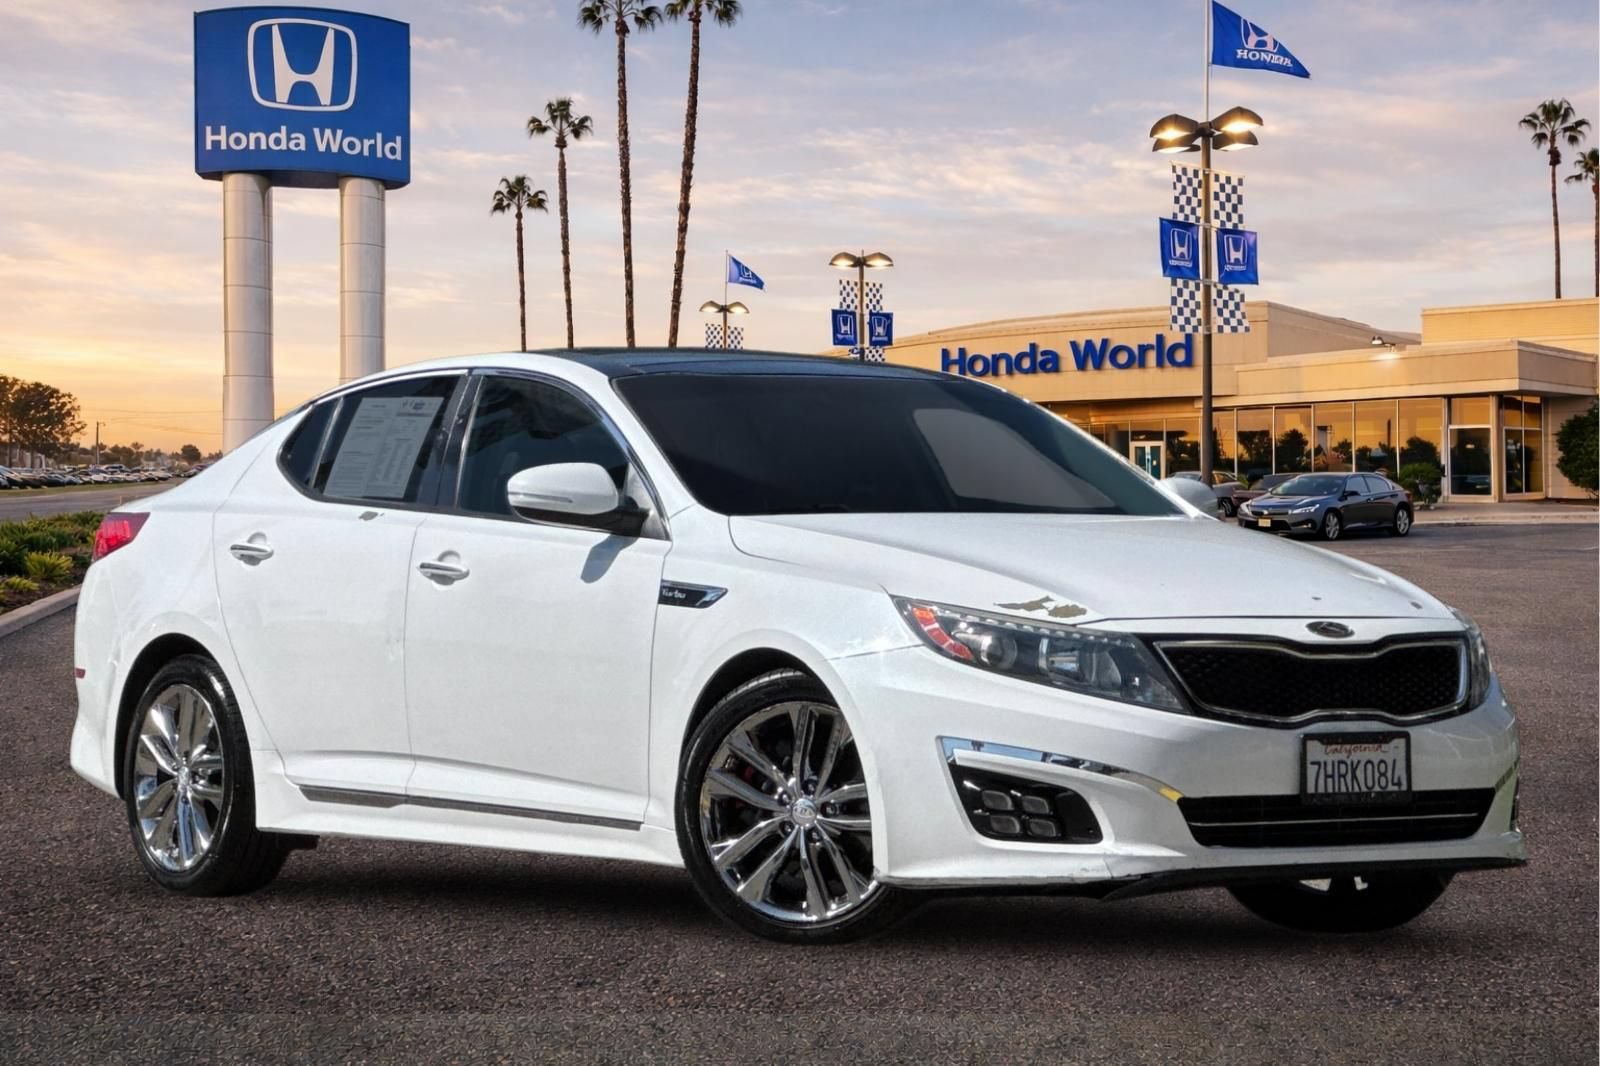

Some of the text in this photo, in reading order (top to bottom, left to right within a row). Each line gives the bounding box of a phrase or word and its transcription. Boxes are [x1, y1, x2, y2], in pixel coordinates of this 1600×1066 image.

[205, 126, 402, 160] Honda World
[940, 332, 1195, 378] Honda World
[1310, 758, 1403, 794] 7HRK084
